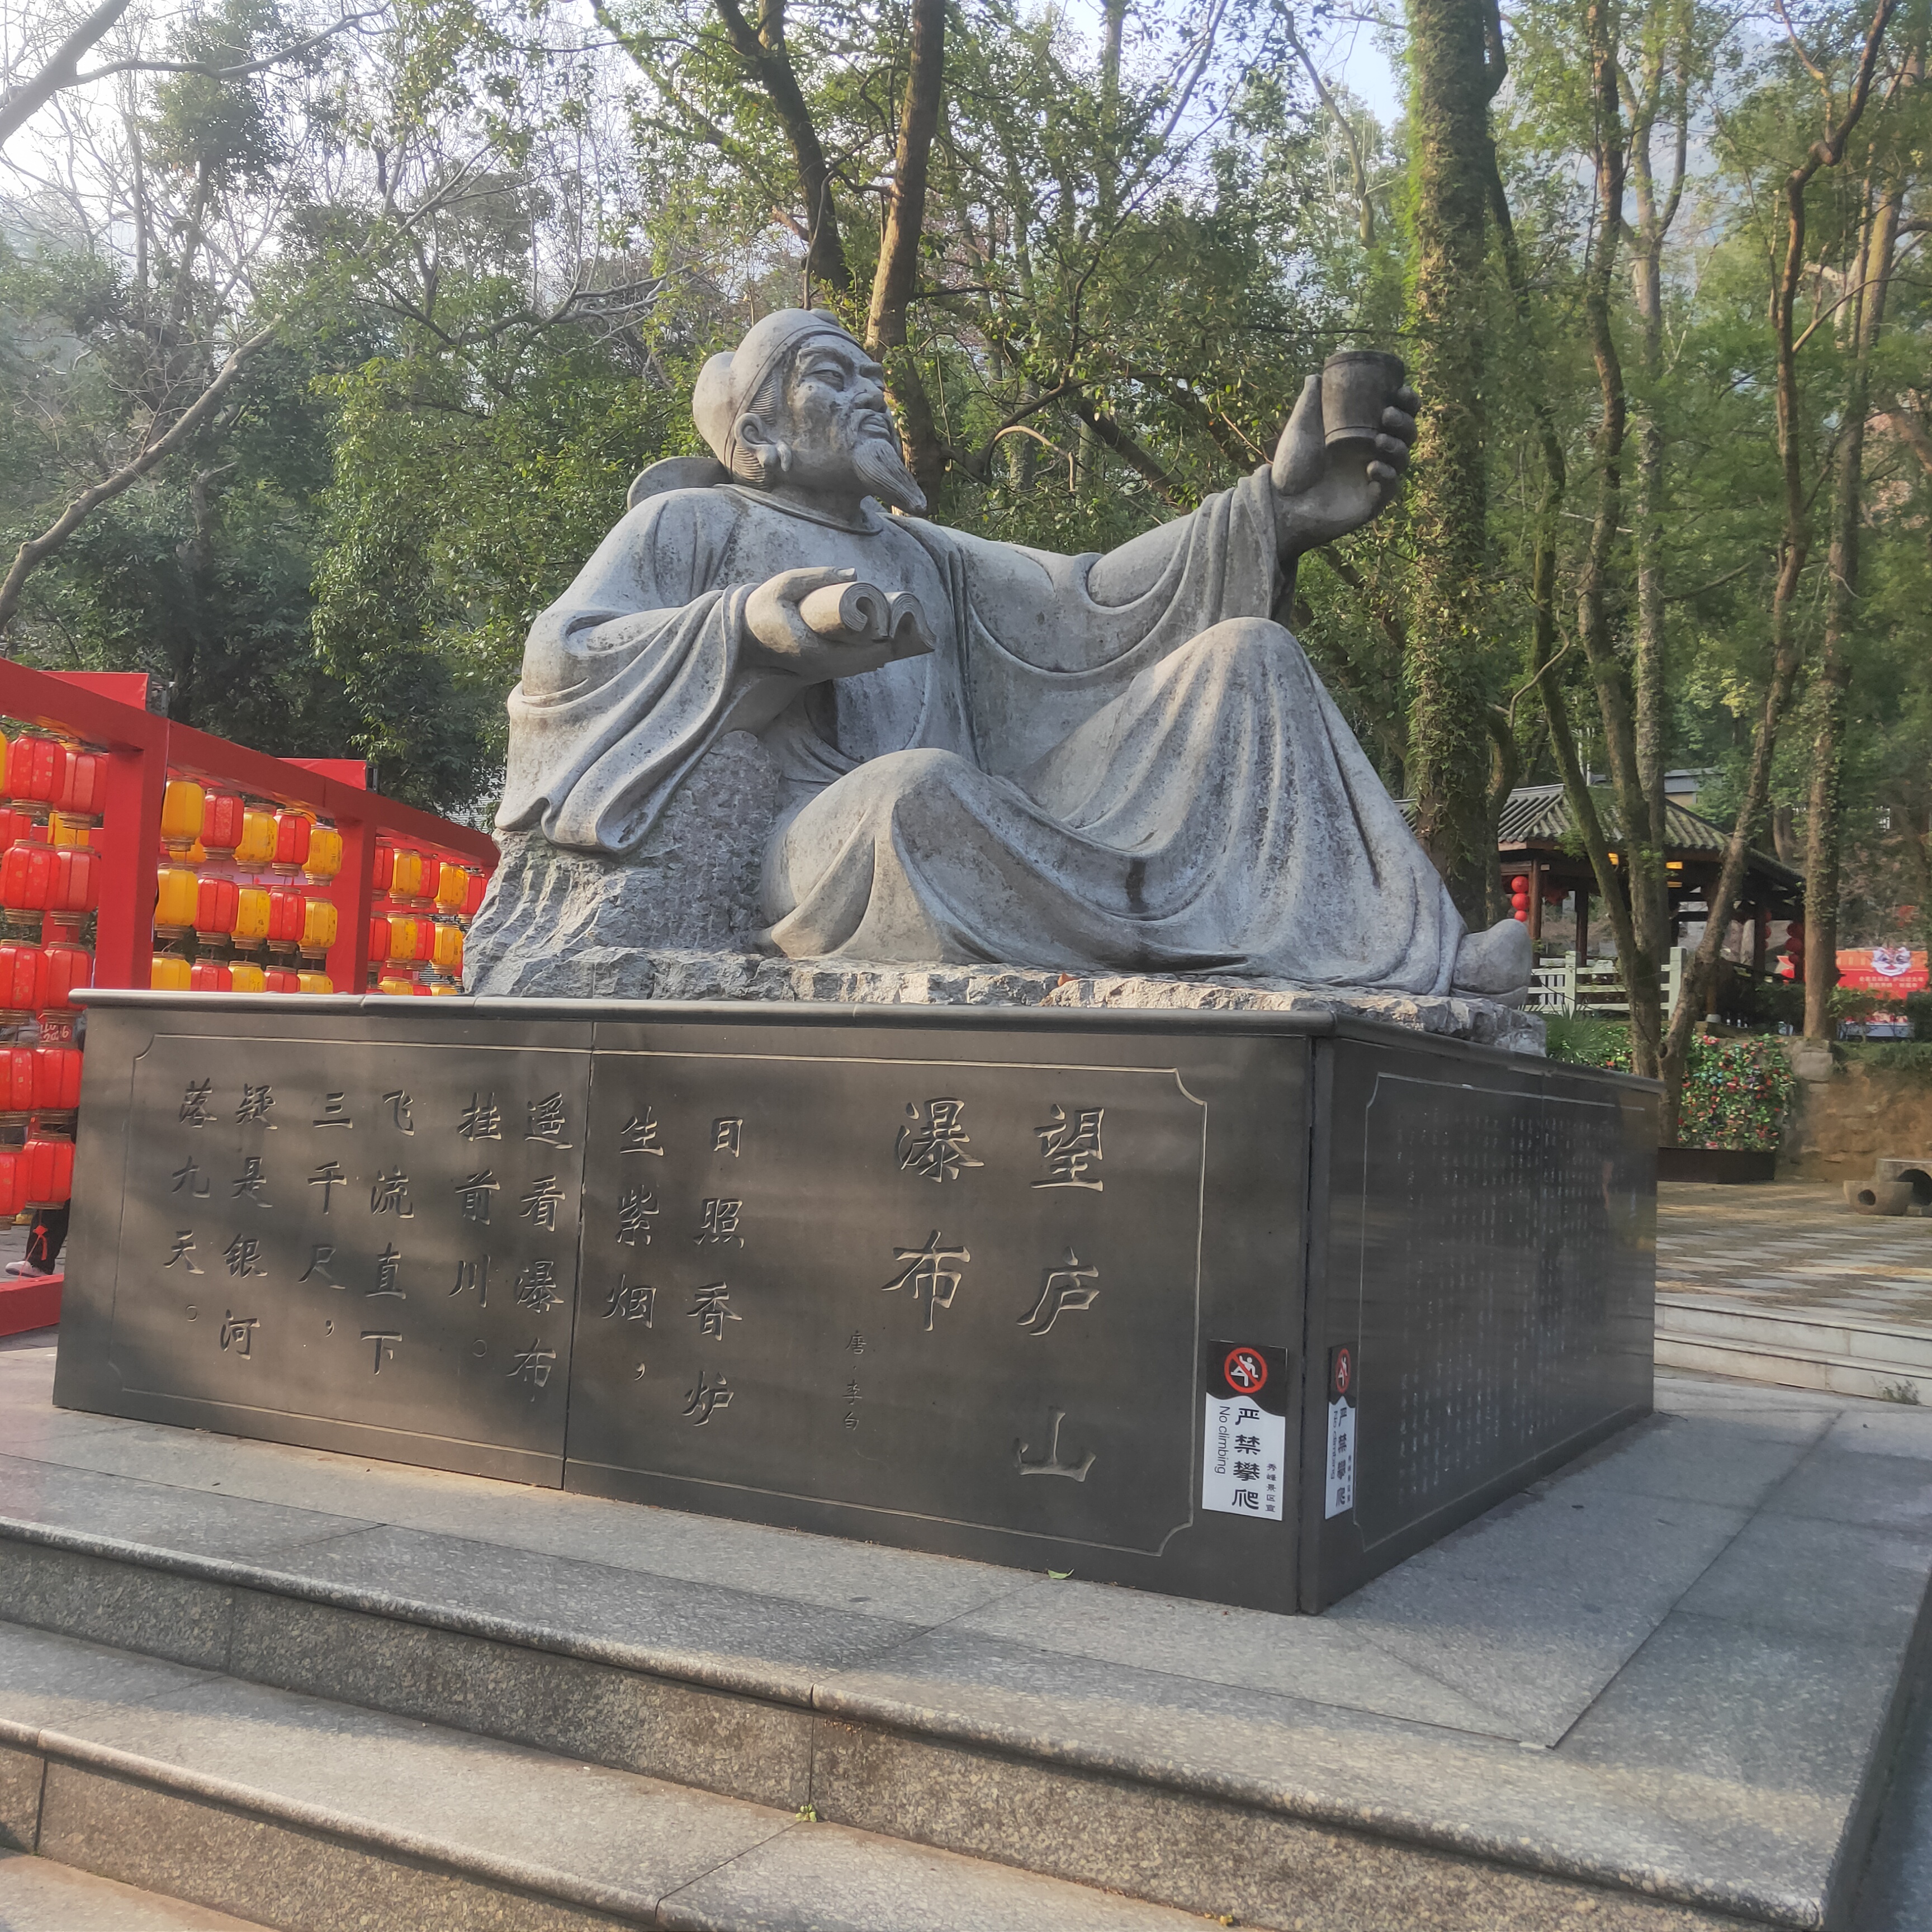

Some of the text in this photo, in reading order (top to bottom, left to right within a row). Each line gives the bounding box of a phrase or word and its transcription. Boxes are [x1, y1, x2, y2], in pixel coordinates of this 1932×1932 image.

[220, 1083, 278, 1360] 疑是银河
[361, 1090, 415, 1375] 飞流直下
[506, 1092, 573, 1387] 遥看瀑布
[683, 1117, 745, 1427] 日照香炉
[882, 1097, 984, 1331] 瀑布
[1013, 1104, 1105, 1483] 望庐山
[1214, 1406, 1230, 1474] No climbing
[1232, 1408, 1261, 1510] 严禁攀爬
